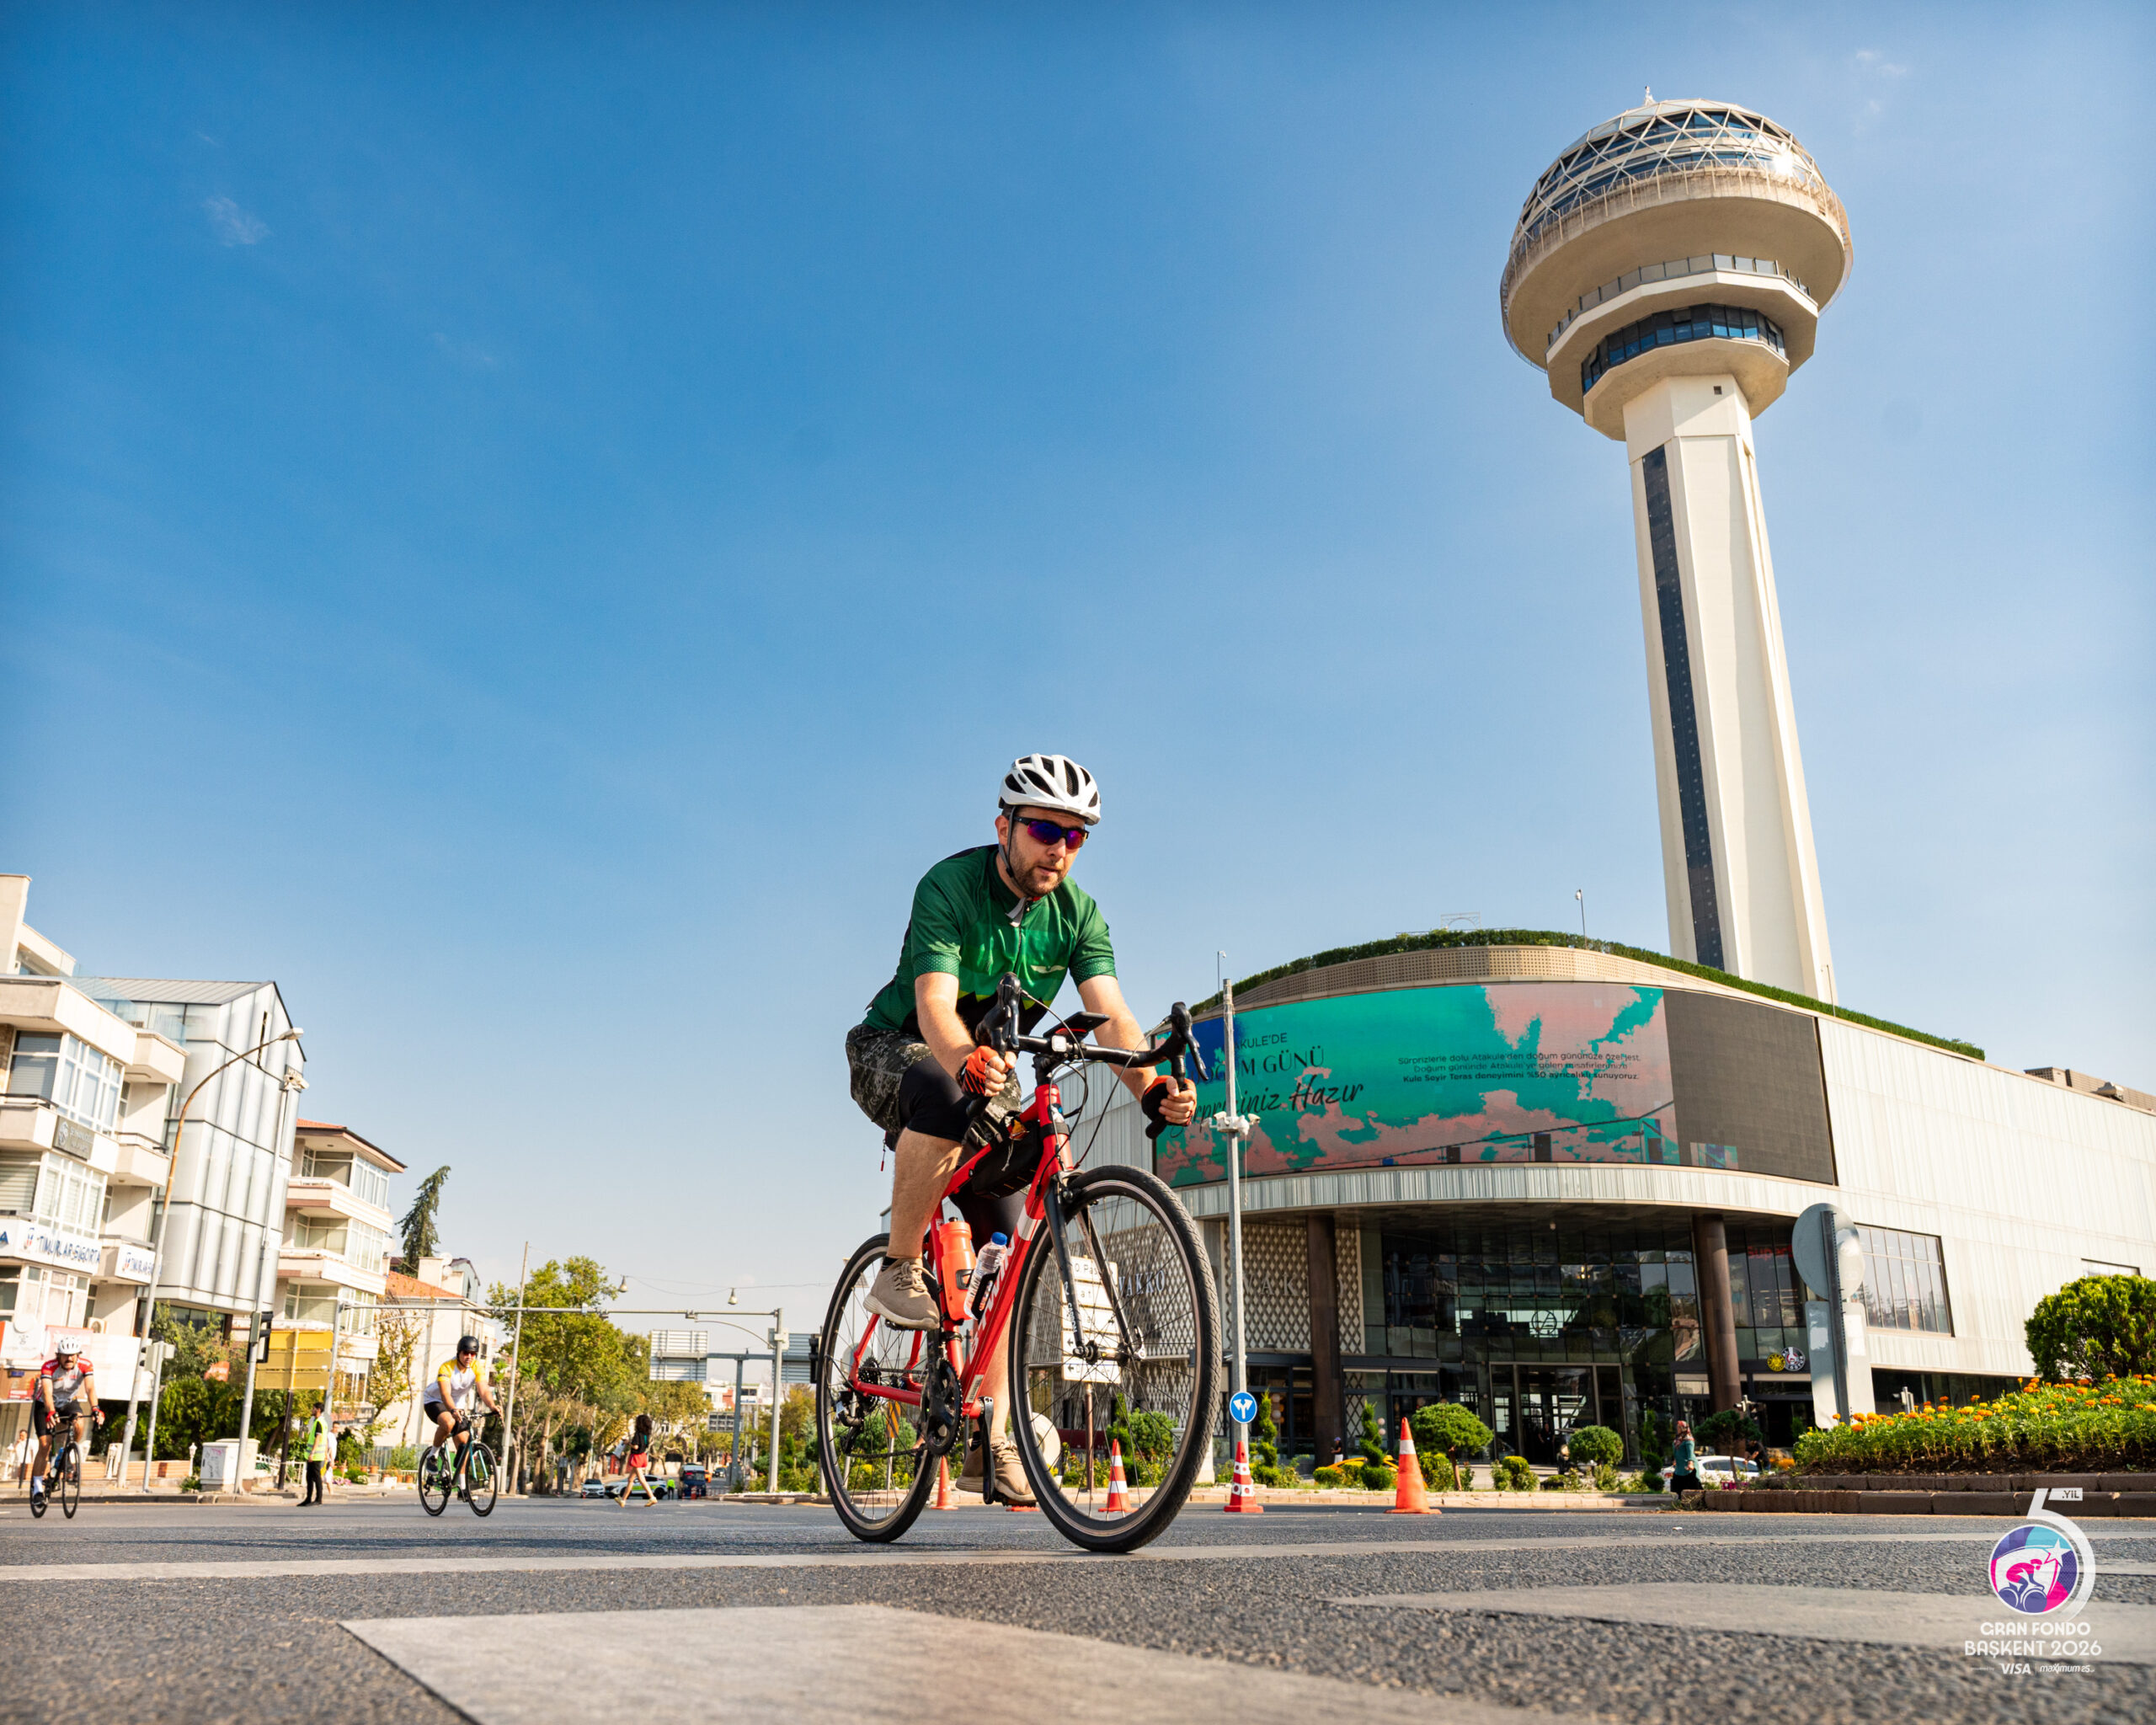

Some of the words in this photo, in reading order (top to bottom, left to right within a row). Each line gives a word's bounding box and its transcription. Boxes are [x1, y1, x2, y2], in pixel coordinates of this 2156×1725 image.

[1263, 1044, 1325, 1073] GÜNÜ
[1449, 1054, 1470, 1062] dolu
[1526, 1053, 1558, 1061] doğum
[1561, 1053, 1604, 1061] gününüze
[1413, 1065, 1446, 1073] Doğum
[1424, 1073, 1447, 1082] Seyir
[1449, 1072, 1473, 1081] Teras
[1475, 1071, 1524, 1080] deneyimini
[1527, 1071, 1546, 1079] %50
[1289, 1074, 1364, 1112] Hazır
[1118, 1269, 1166, 1297] VAKKO
